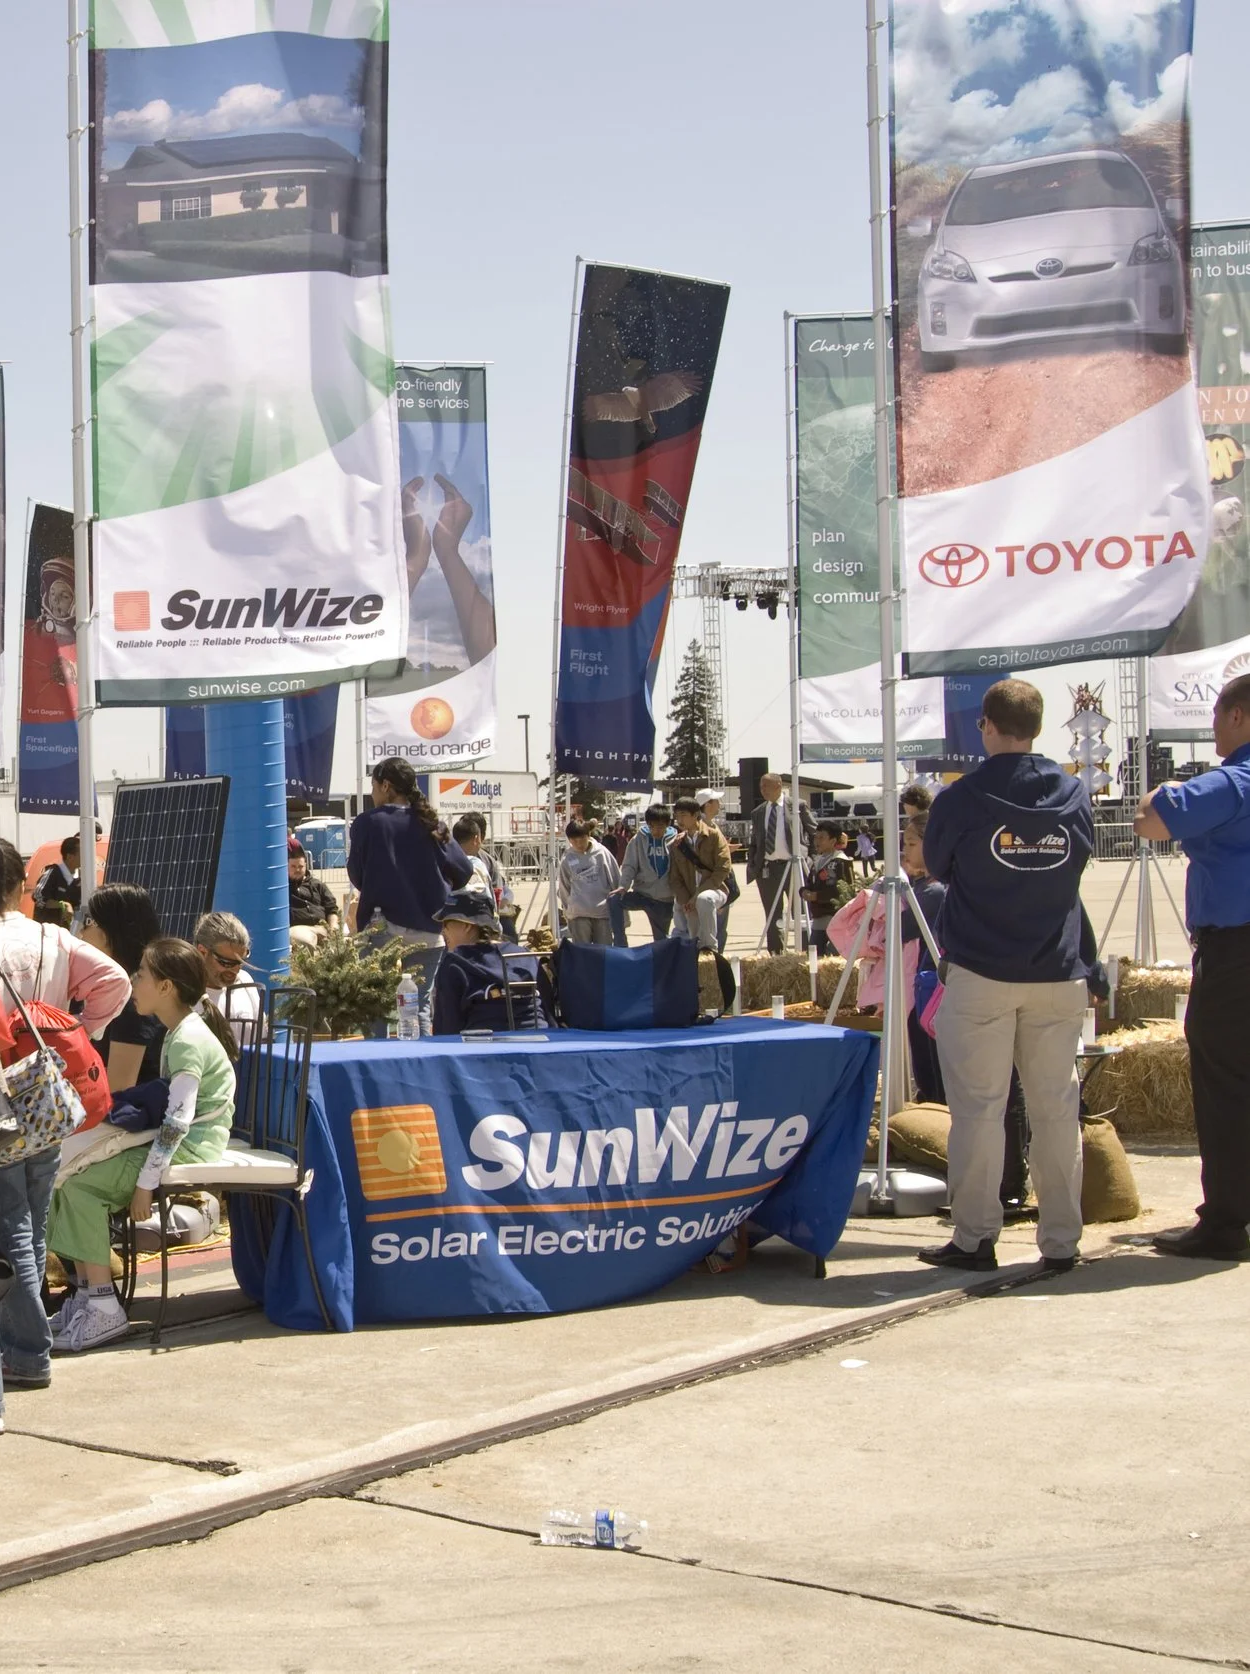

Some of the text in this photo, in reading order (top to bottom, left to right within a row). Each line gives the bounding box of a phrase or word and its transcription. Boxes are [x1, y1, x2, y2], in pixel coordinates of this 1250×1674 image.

[1207, 264, 1222, 276] to
[808, 338, 860, 358] Change
[418, 396, 470, 409] services
[812, 528, 845, 546] plan
[995, 531, 1196, 577] TOYOTA
[812, 557, 863, 576] design
[161, 588, 384, 631] SunWize
[574, 602, 630, 614] Wright Flyer
[116, 639, 153, 649] Reliable
[156, 638, 187, 649] People
[203, 637, 241, 646] Reliable
[244, 635, 288, 646] Products
[303, 634, 341, 643] Reliable
[569, 649, 602, 662] First
[978, 636, 1129, 668] capitoltoyota.com
[569, 662, 610, 677] Flight
[187, 678, 305, 698] sunwise.com
[25, 735, 47, 744] First
[25, 744, 78, 754] Spaceflight
[372, 738, 491, 760] planet orange
[471, 779, 502, 799] Budget
[461, 1101, 809, 1191] SunWize
[370, 1200, 763, 1265] Solar Electric Solutio
